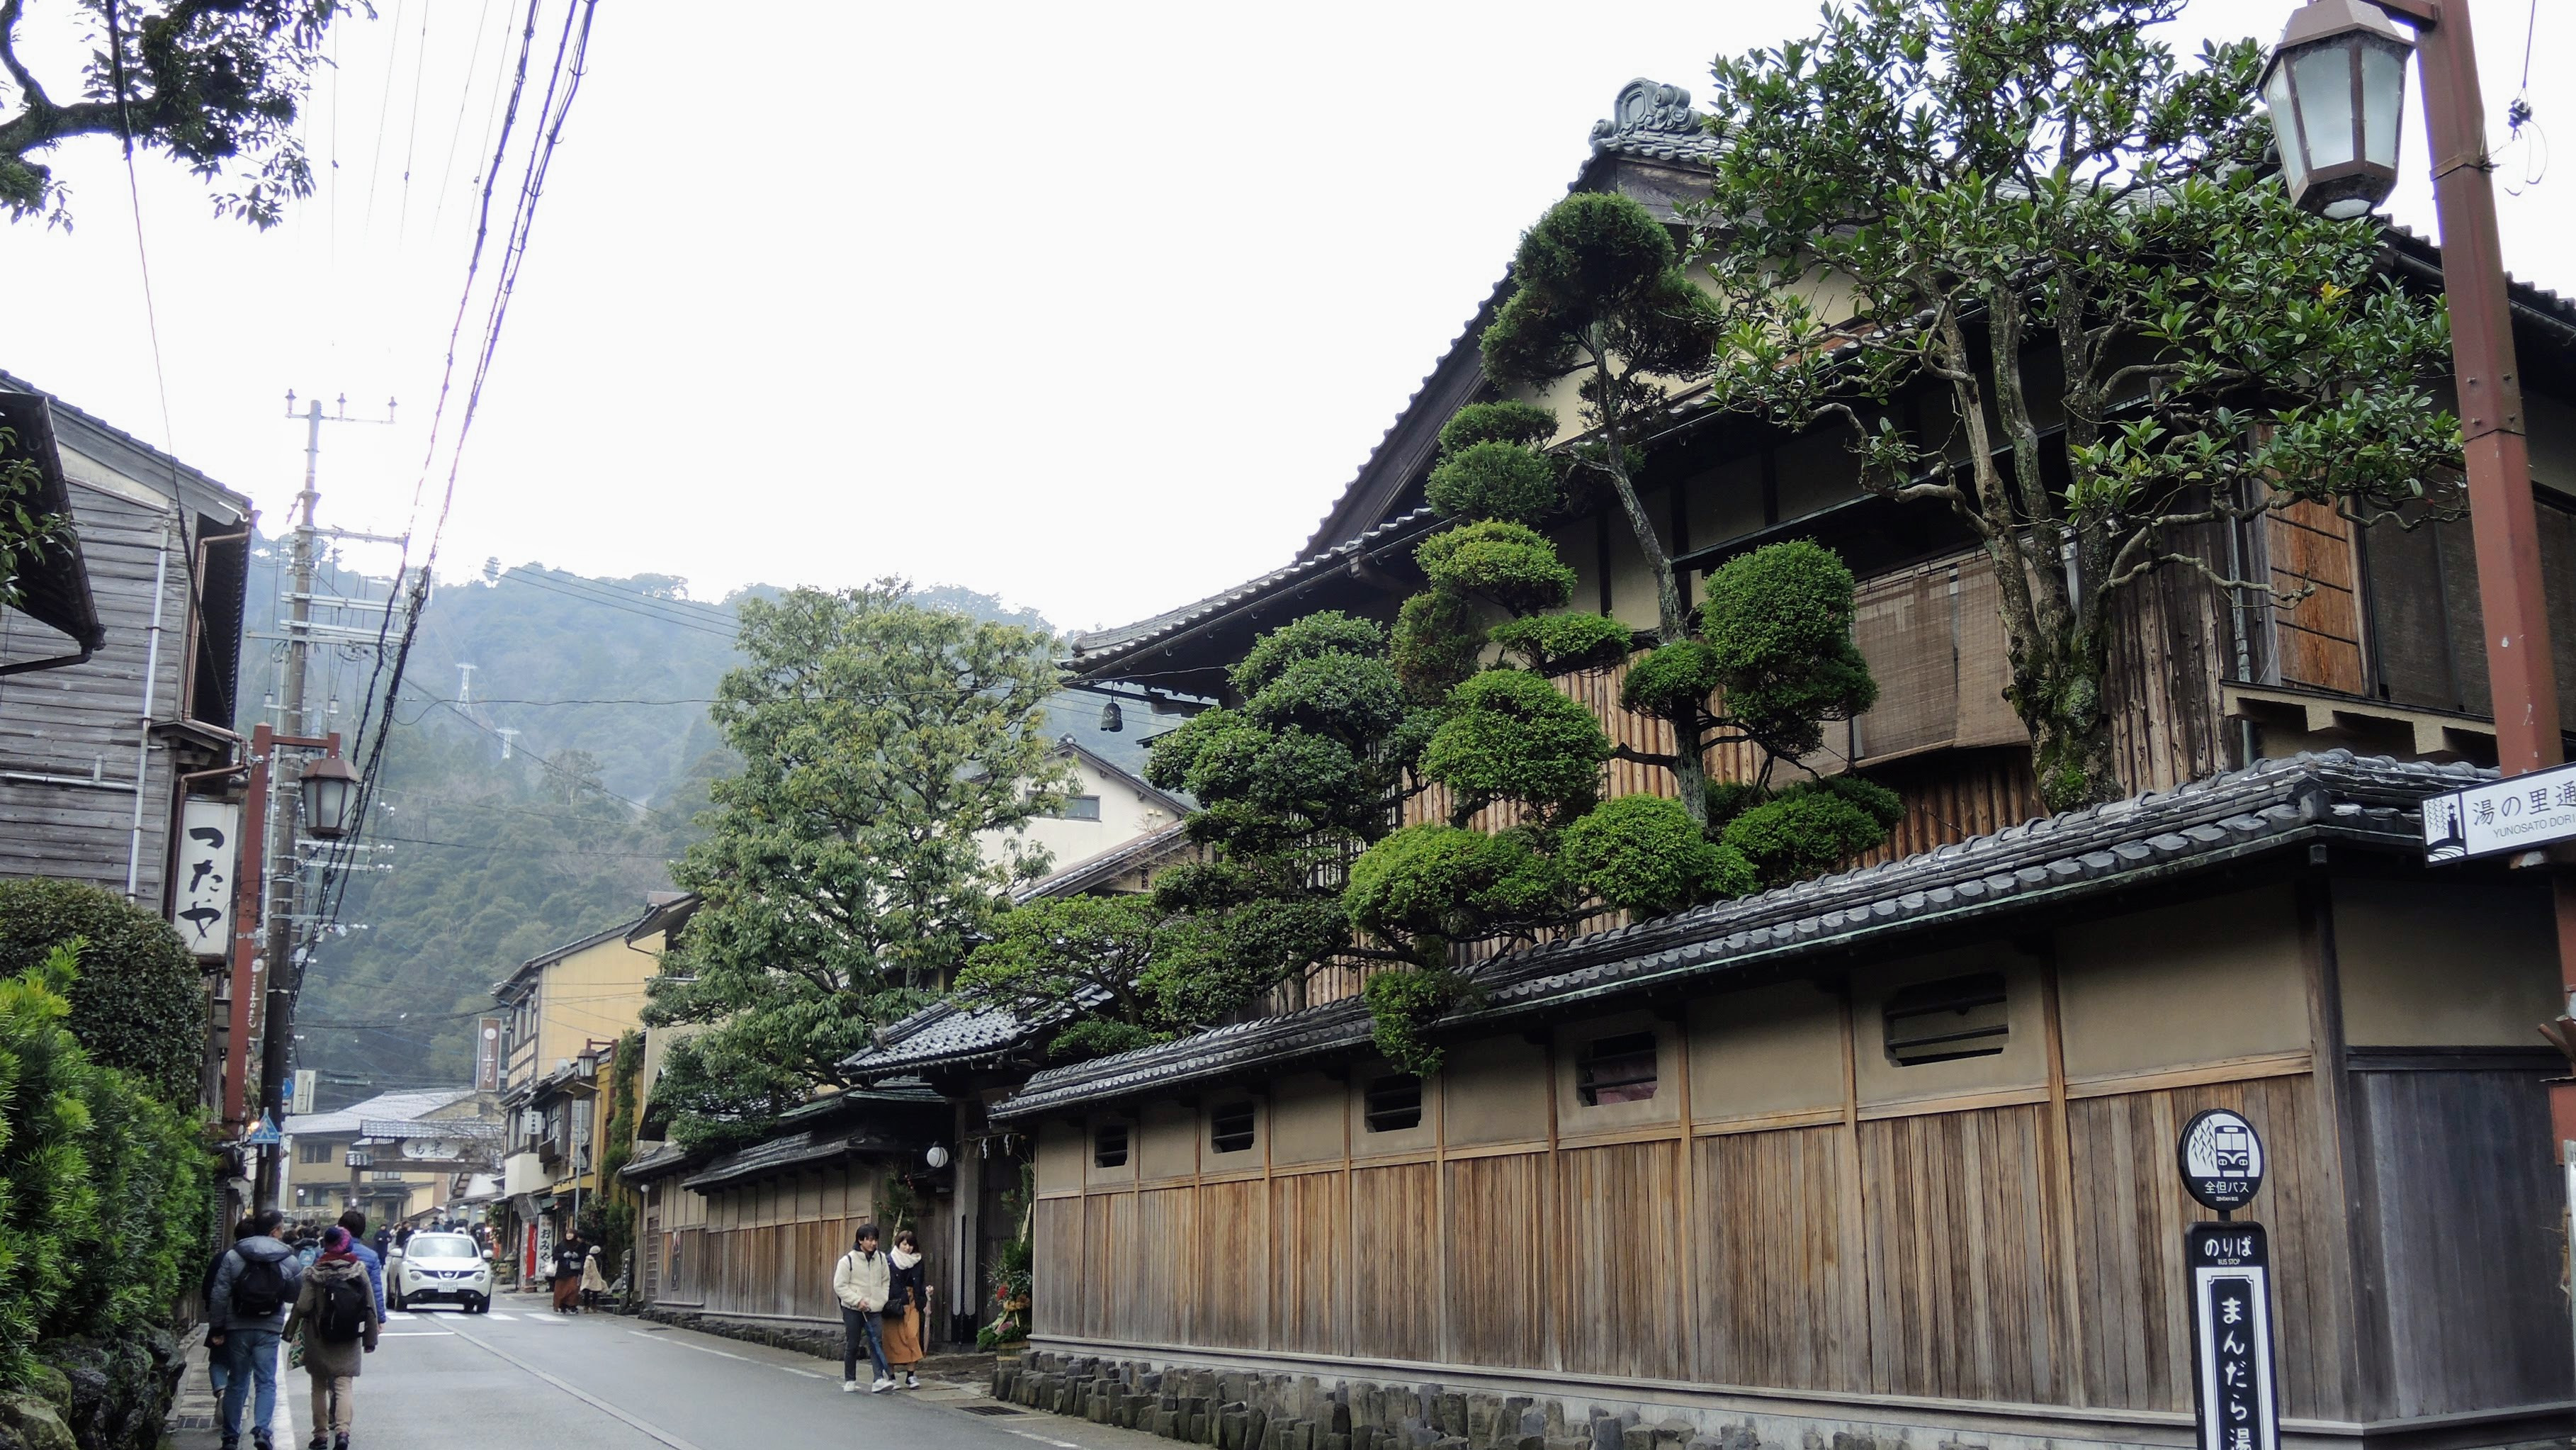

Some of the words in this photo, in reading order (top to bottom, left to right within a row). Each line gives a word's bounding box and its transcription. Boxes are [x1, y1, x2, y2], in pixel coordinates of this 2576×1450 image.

[2493, 819, 2547, 838] YUNOSATO
[2550, 814, 2576, 827] DORI
[177, 826, 225, 939] つたや
[2204, 1181, 2249, 1194] 全但バス
[2205, 1235, 2252, 1257] のりば
